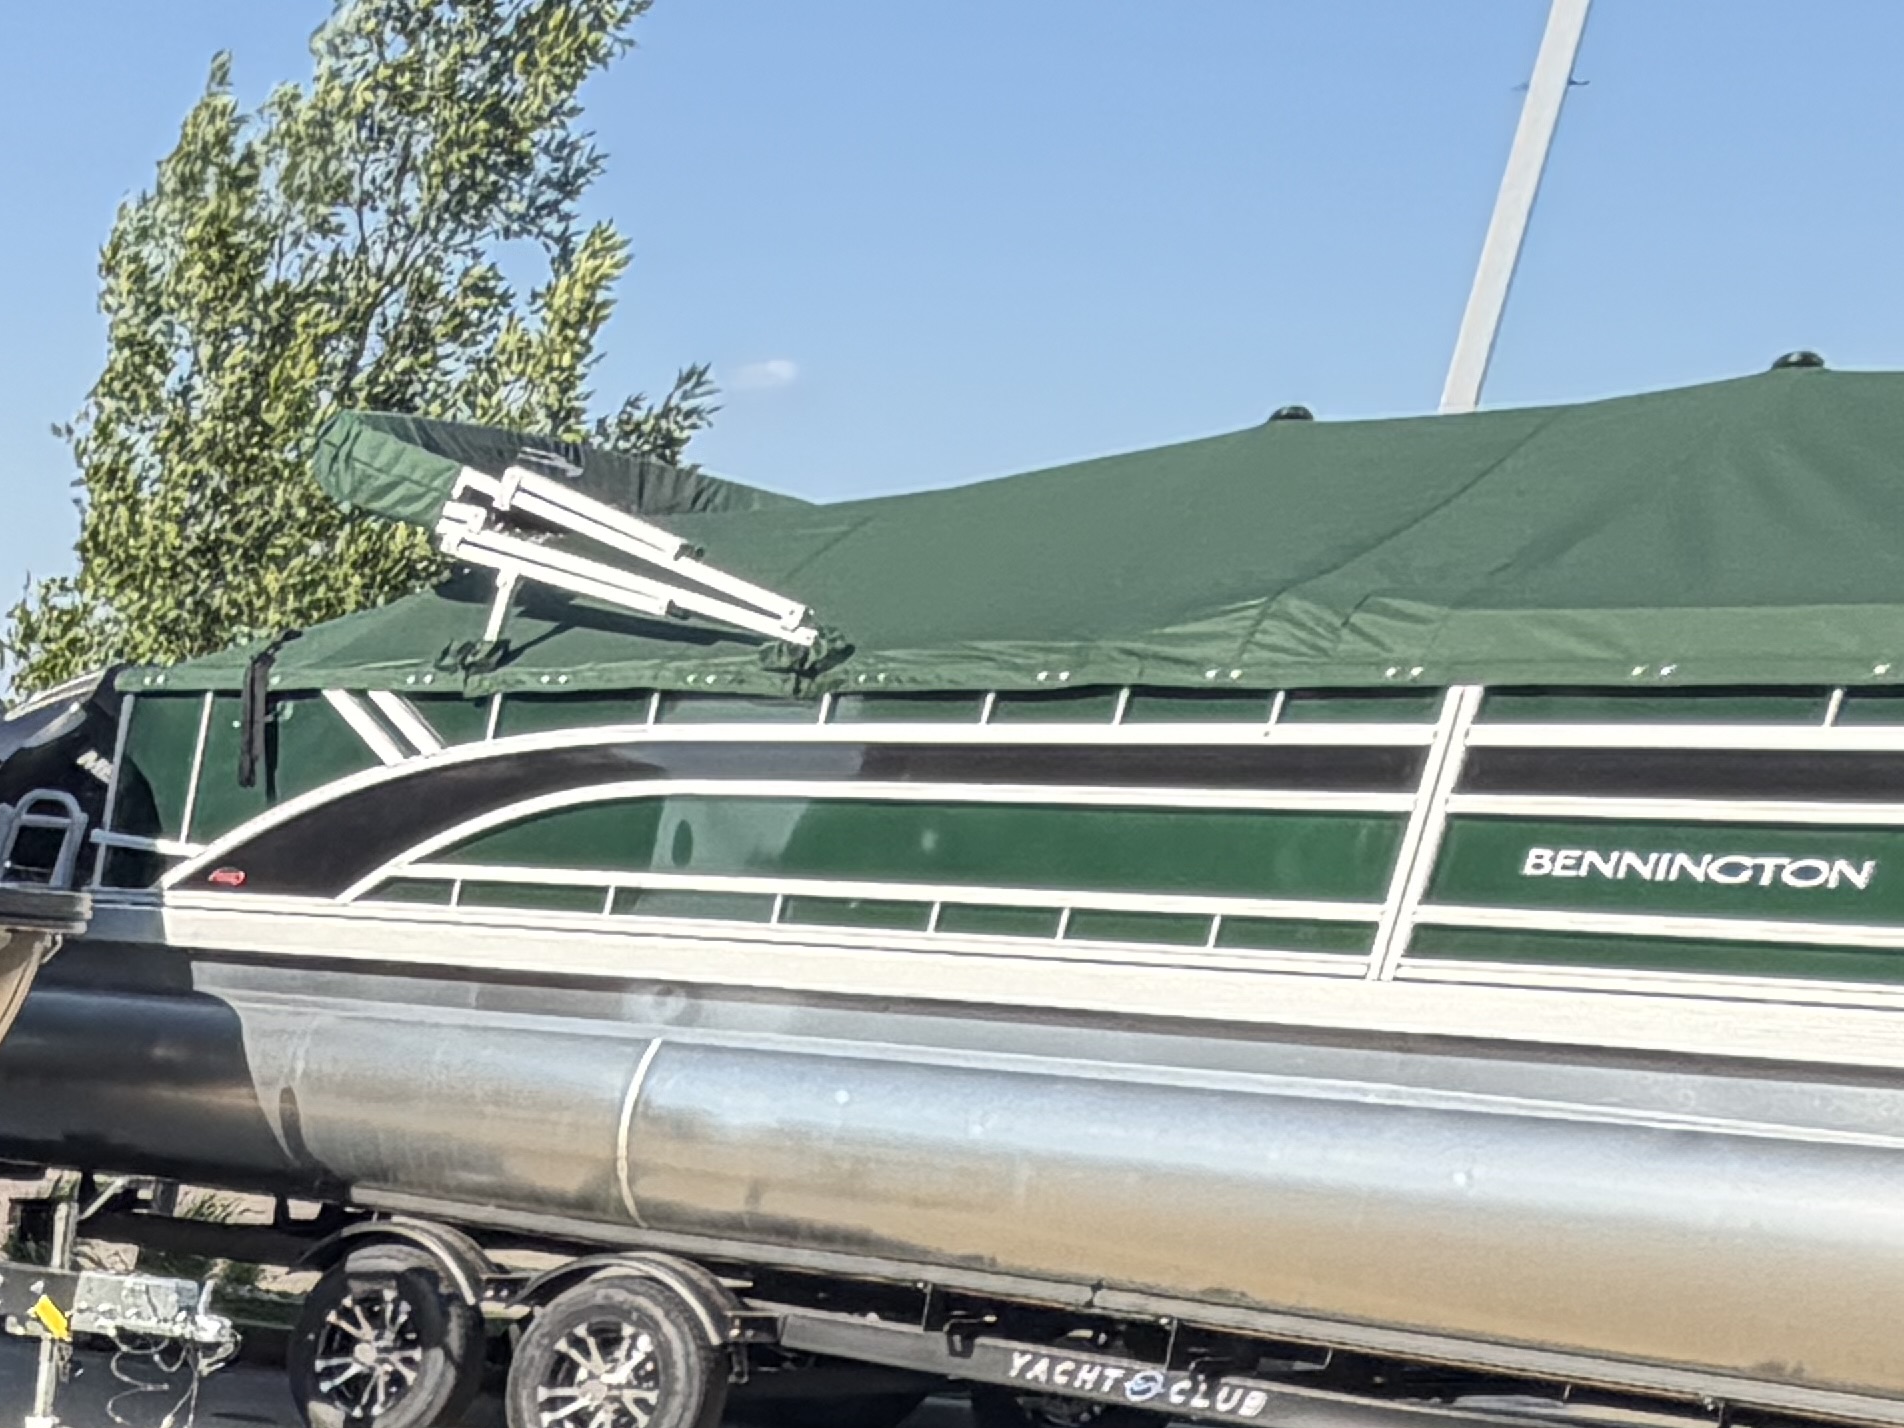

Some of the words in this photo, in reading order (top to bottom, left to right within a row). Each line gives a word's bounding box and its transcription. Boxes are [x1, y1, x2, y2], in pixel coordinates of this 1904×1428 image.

[1522, 847, 1876, 889] BENNINGTON
[1008, 1351, 1126, 1393] YACHT
[1169, 1378, 1269, 1417] CLUB
